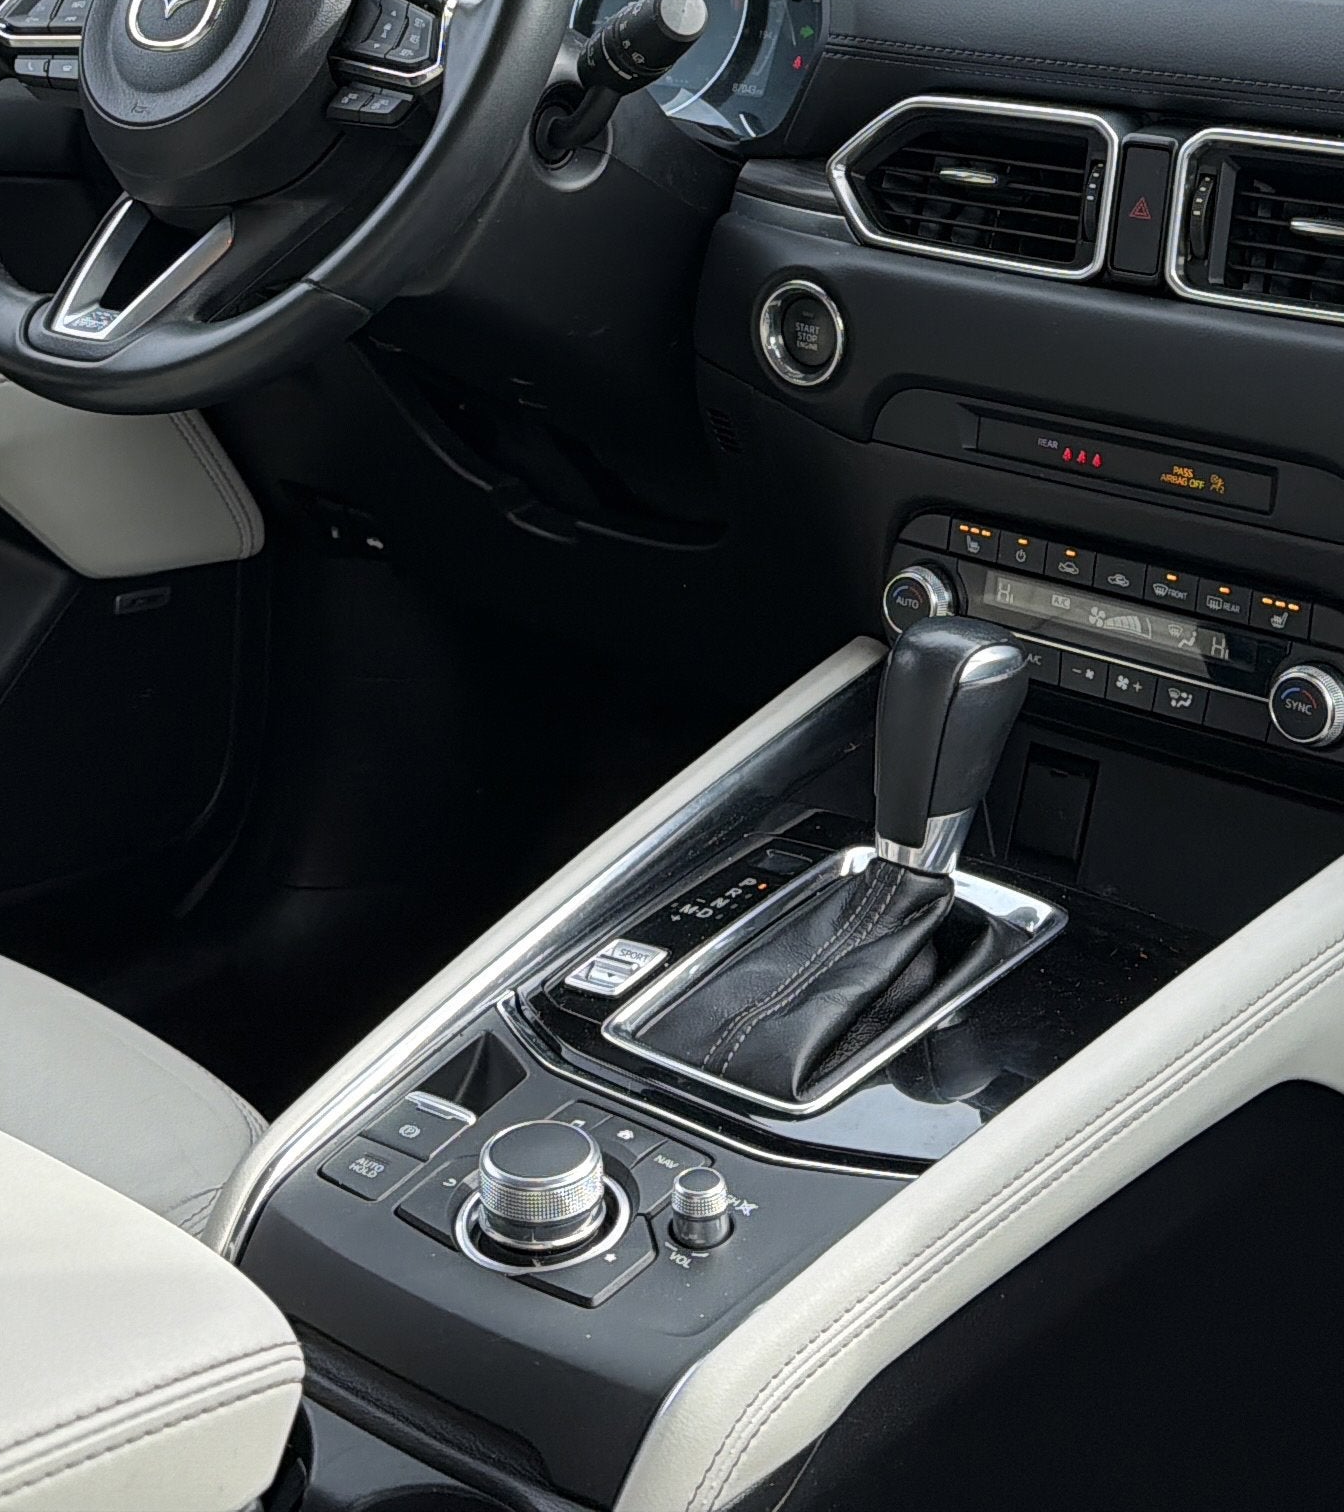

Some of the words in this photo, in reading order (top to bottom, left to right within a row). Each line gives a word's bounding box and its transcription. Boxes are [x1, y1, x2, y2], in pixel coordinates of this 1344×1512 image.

[795, 322, 820, 334] START
[797, 331, 817, 342] STOP
[1037, 437, 1058, 449] REAR
[1173, 466, 1194, 478] PASS
[1160, 473, 1188, 487] AIRBAG
[1189, 478, 1205, 490] OFF
[1168, 589, 1188, 601] FRONT
[896, 597, 919, 610] AUTO
[1223, 602, 1241, 614] REAR
[1285, 698, 1313, 716] SYNC
[619, 948, 651, 962] SPORT
[355, 1157, 385, 1173] AUTO
[653, 1154, 679, 1169] NAV
[348, 1163, 378, 1179] HOLD
[669, 1251, 692, 1269] VOL
